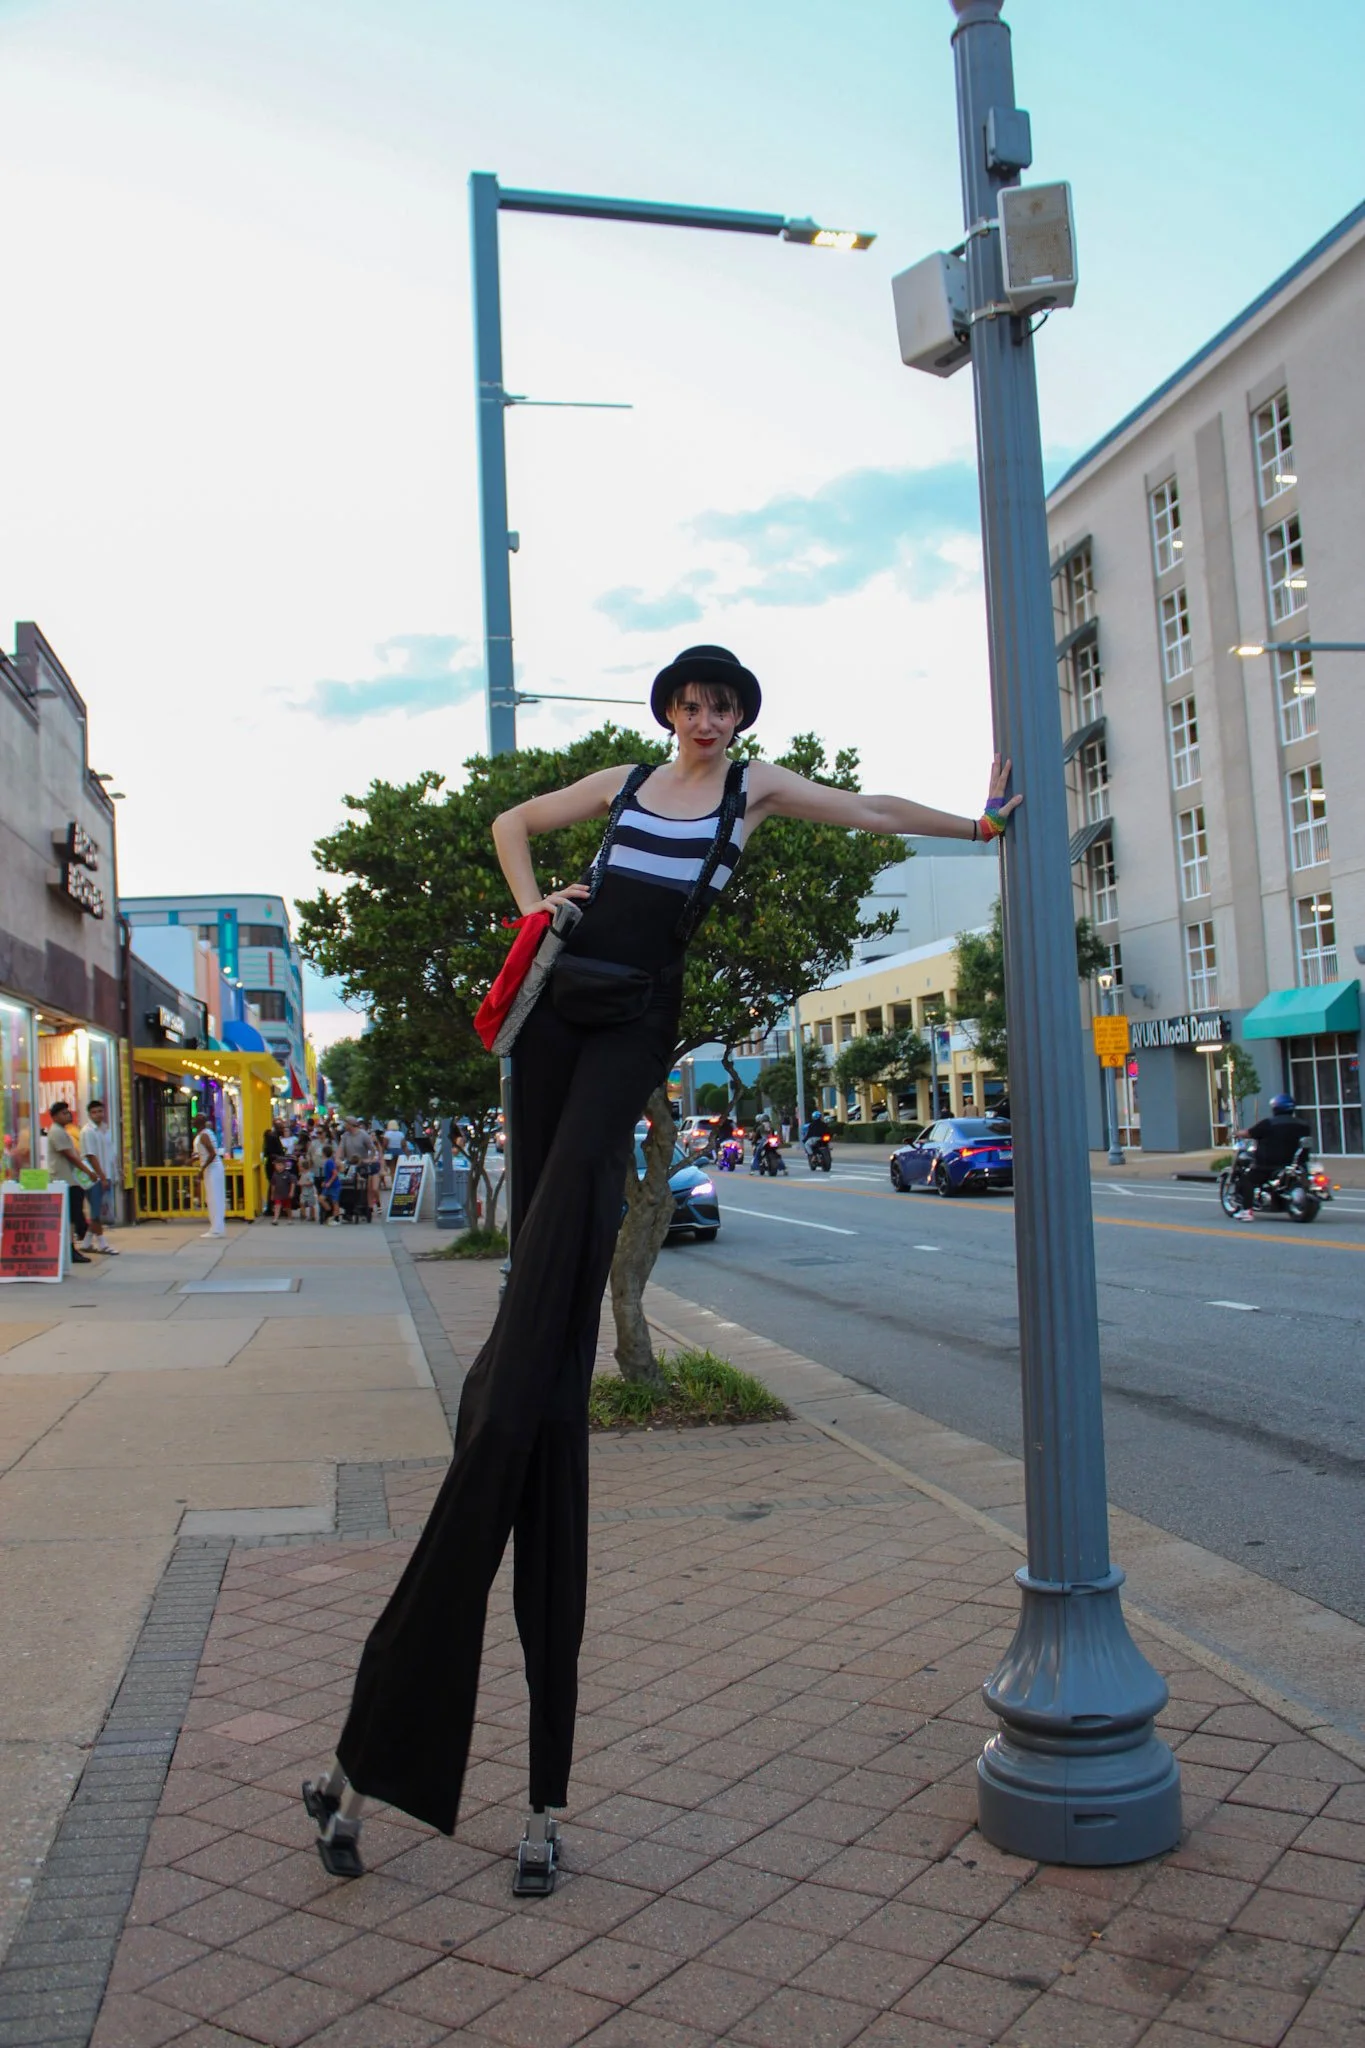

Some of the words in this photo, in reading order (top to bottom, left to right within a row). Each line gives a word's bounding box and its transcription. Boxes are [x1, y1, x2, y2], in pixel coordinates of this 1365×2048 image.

[1159, 1017, 1189, 1046] Mochi
[1190, 1015, 1222, 1042] Donut
[14, 1232, 46, 1243] OVER
